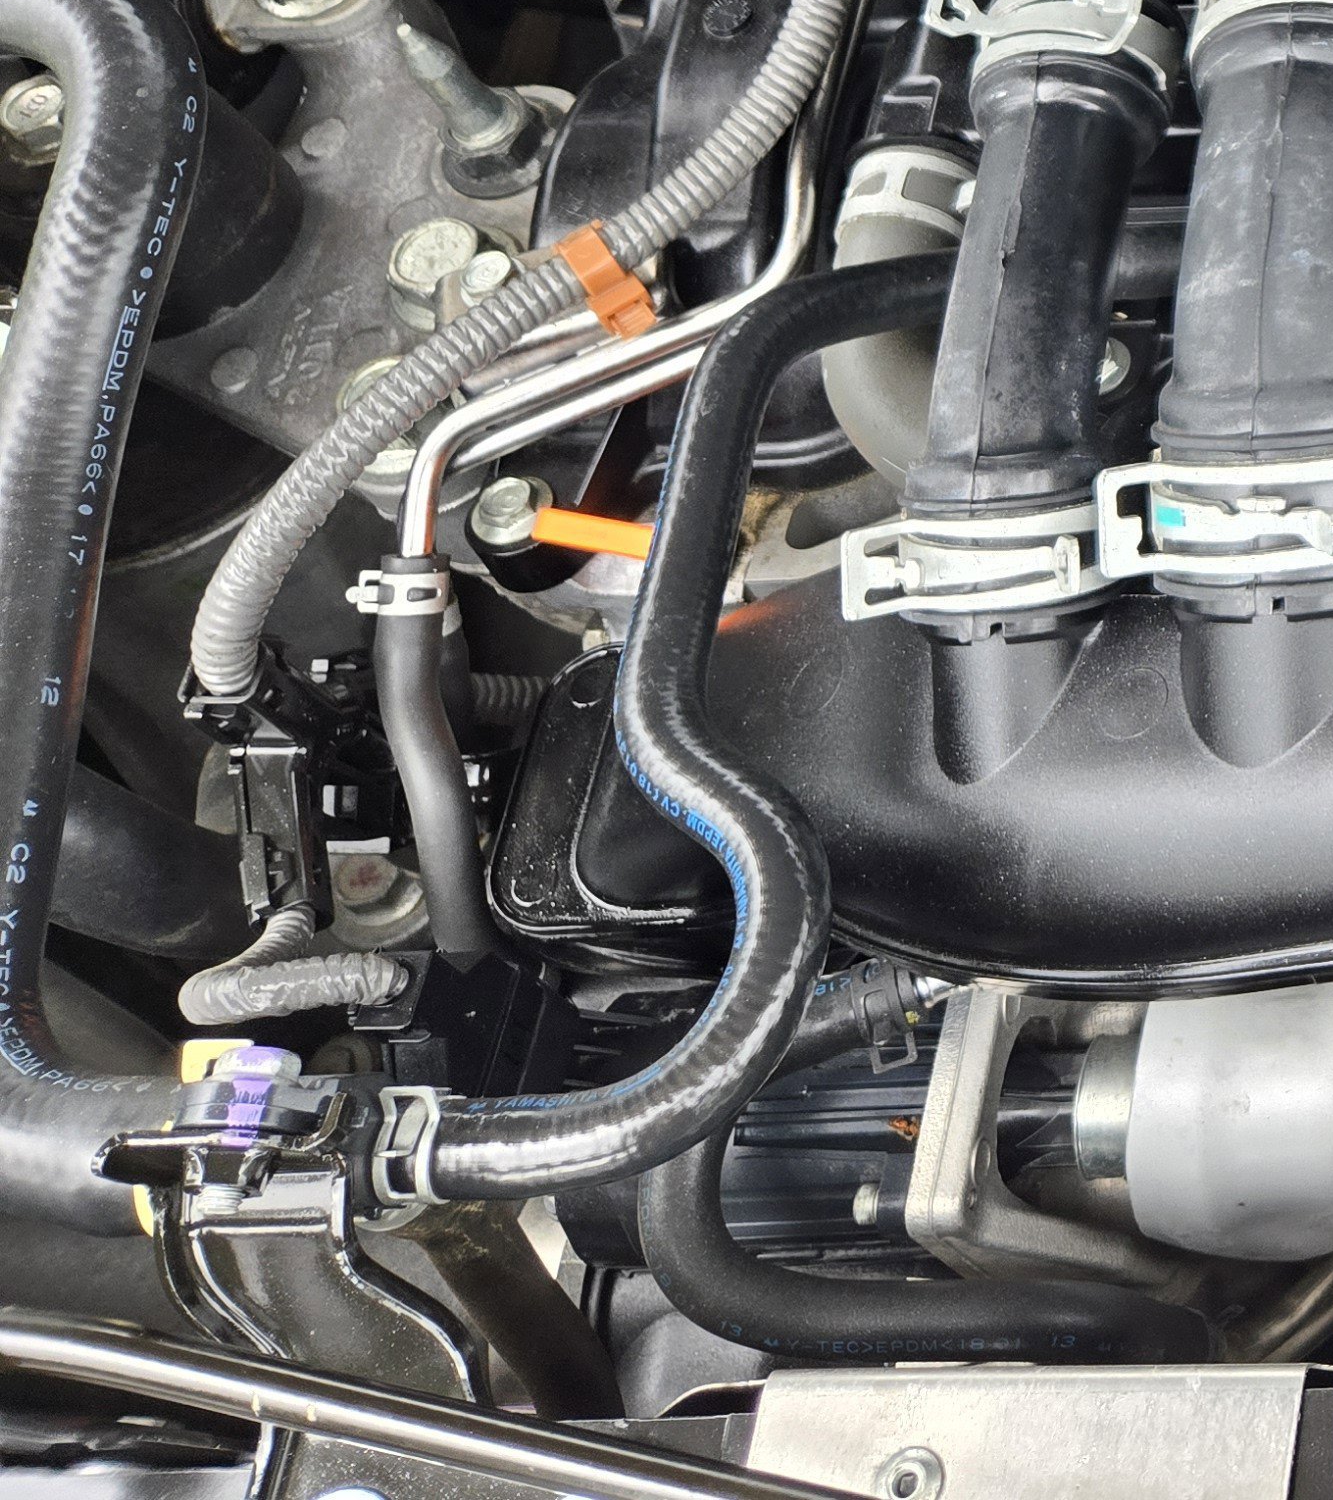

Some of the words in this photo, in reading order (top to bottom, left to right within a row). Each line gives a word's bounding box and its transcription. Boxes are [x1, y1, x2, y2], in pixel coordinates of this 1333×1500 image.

[181, 95, 199, 131] C2
[146, 157, 188, 256] Y-TEC
[66, 533, 88, 567] 17
[5, 842, 30, 884] C2
